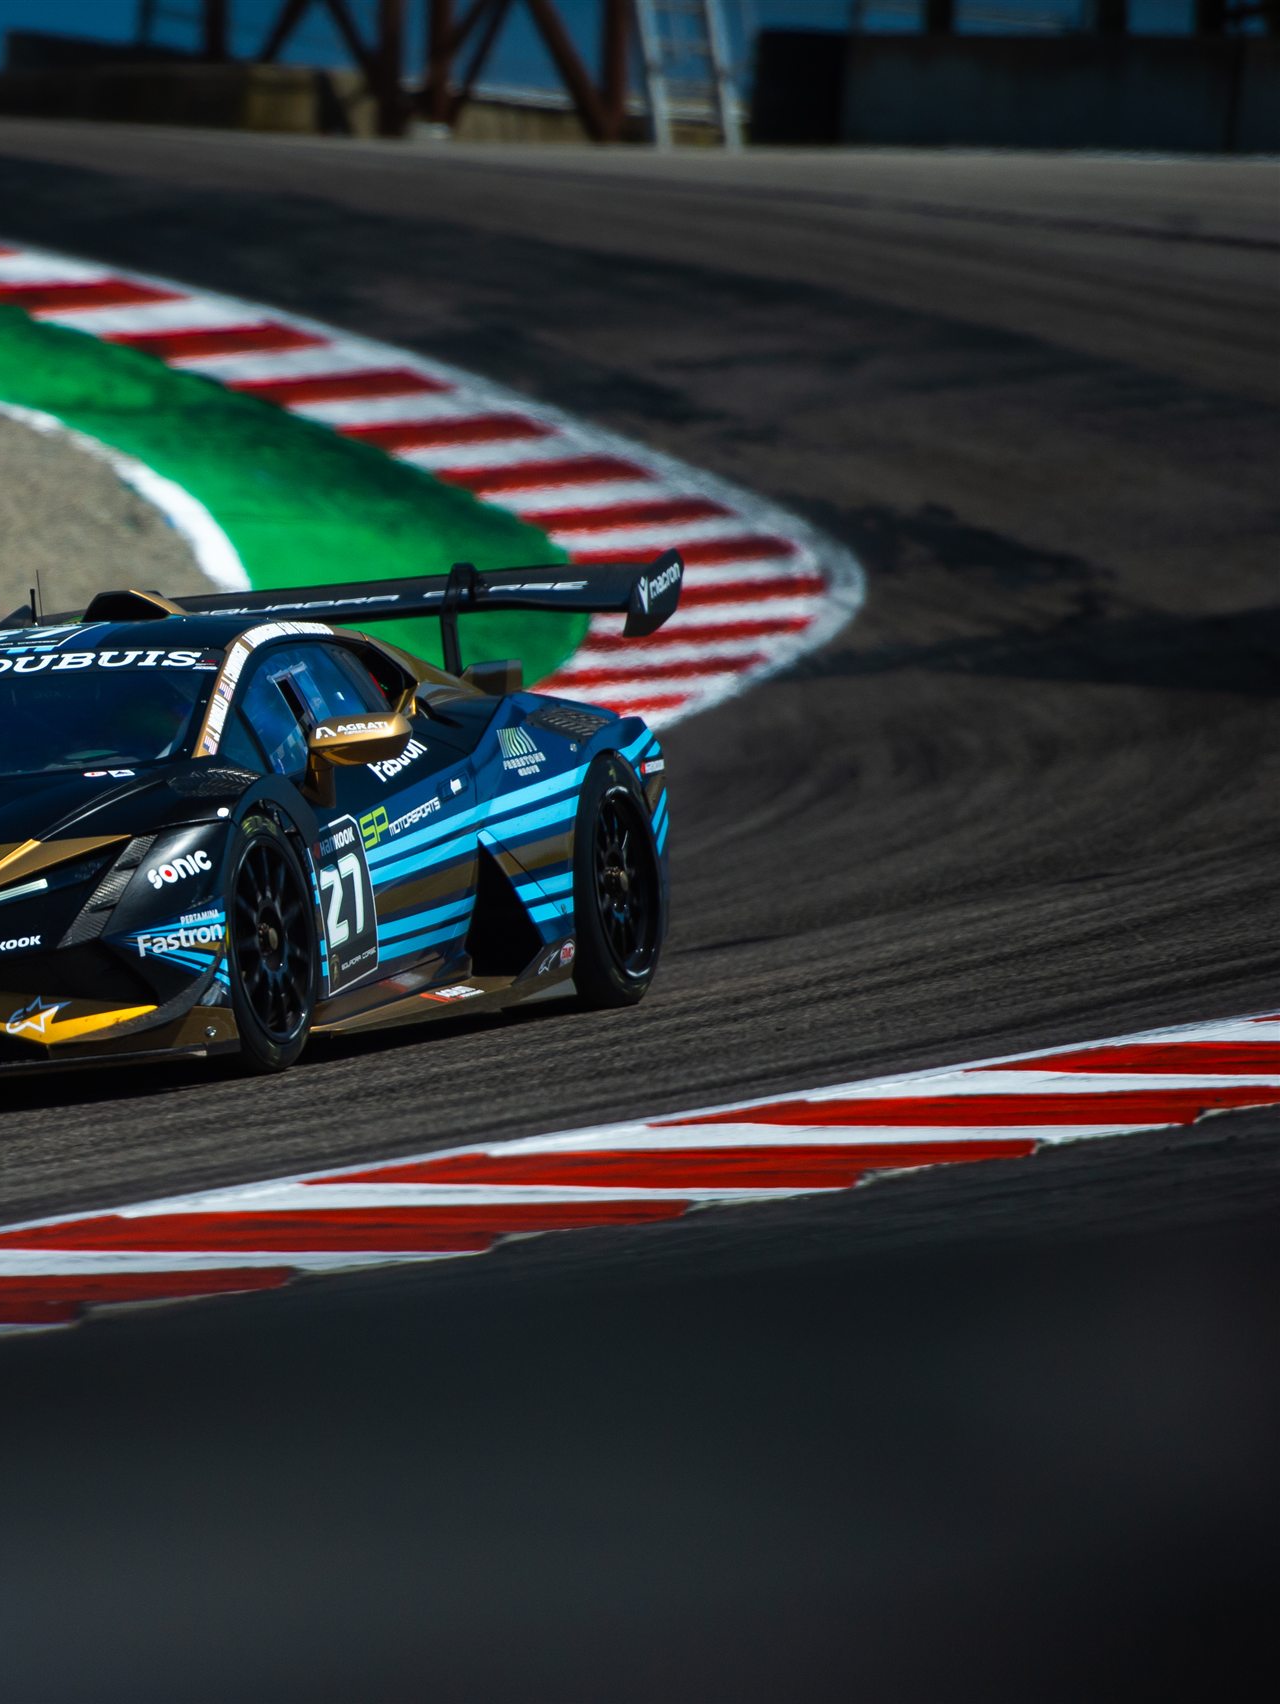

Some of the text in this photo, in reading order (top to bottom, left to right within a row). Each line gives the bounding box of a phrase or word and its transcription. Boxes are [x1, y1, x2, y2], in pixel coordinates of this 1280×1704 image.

[337, 720, 389, 733] AGRATI
[359, 796, 441, 849] SP MOTORSPORTS
[180, 909, 220, 926] PERTAMINA
[320, 853, 365, 949] 27
[137, 923, 223, 958] Fastron
